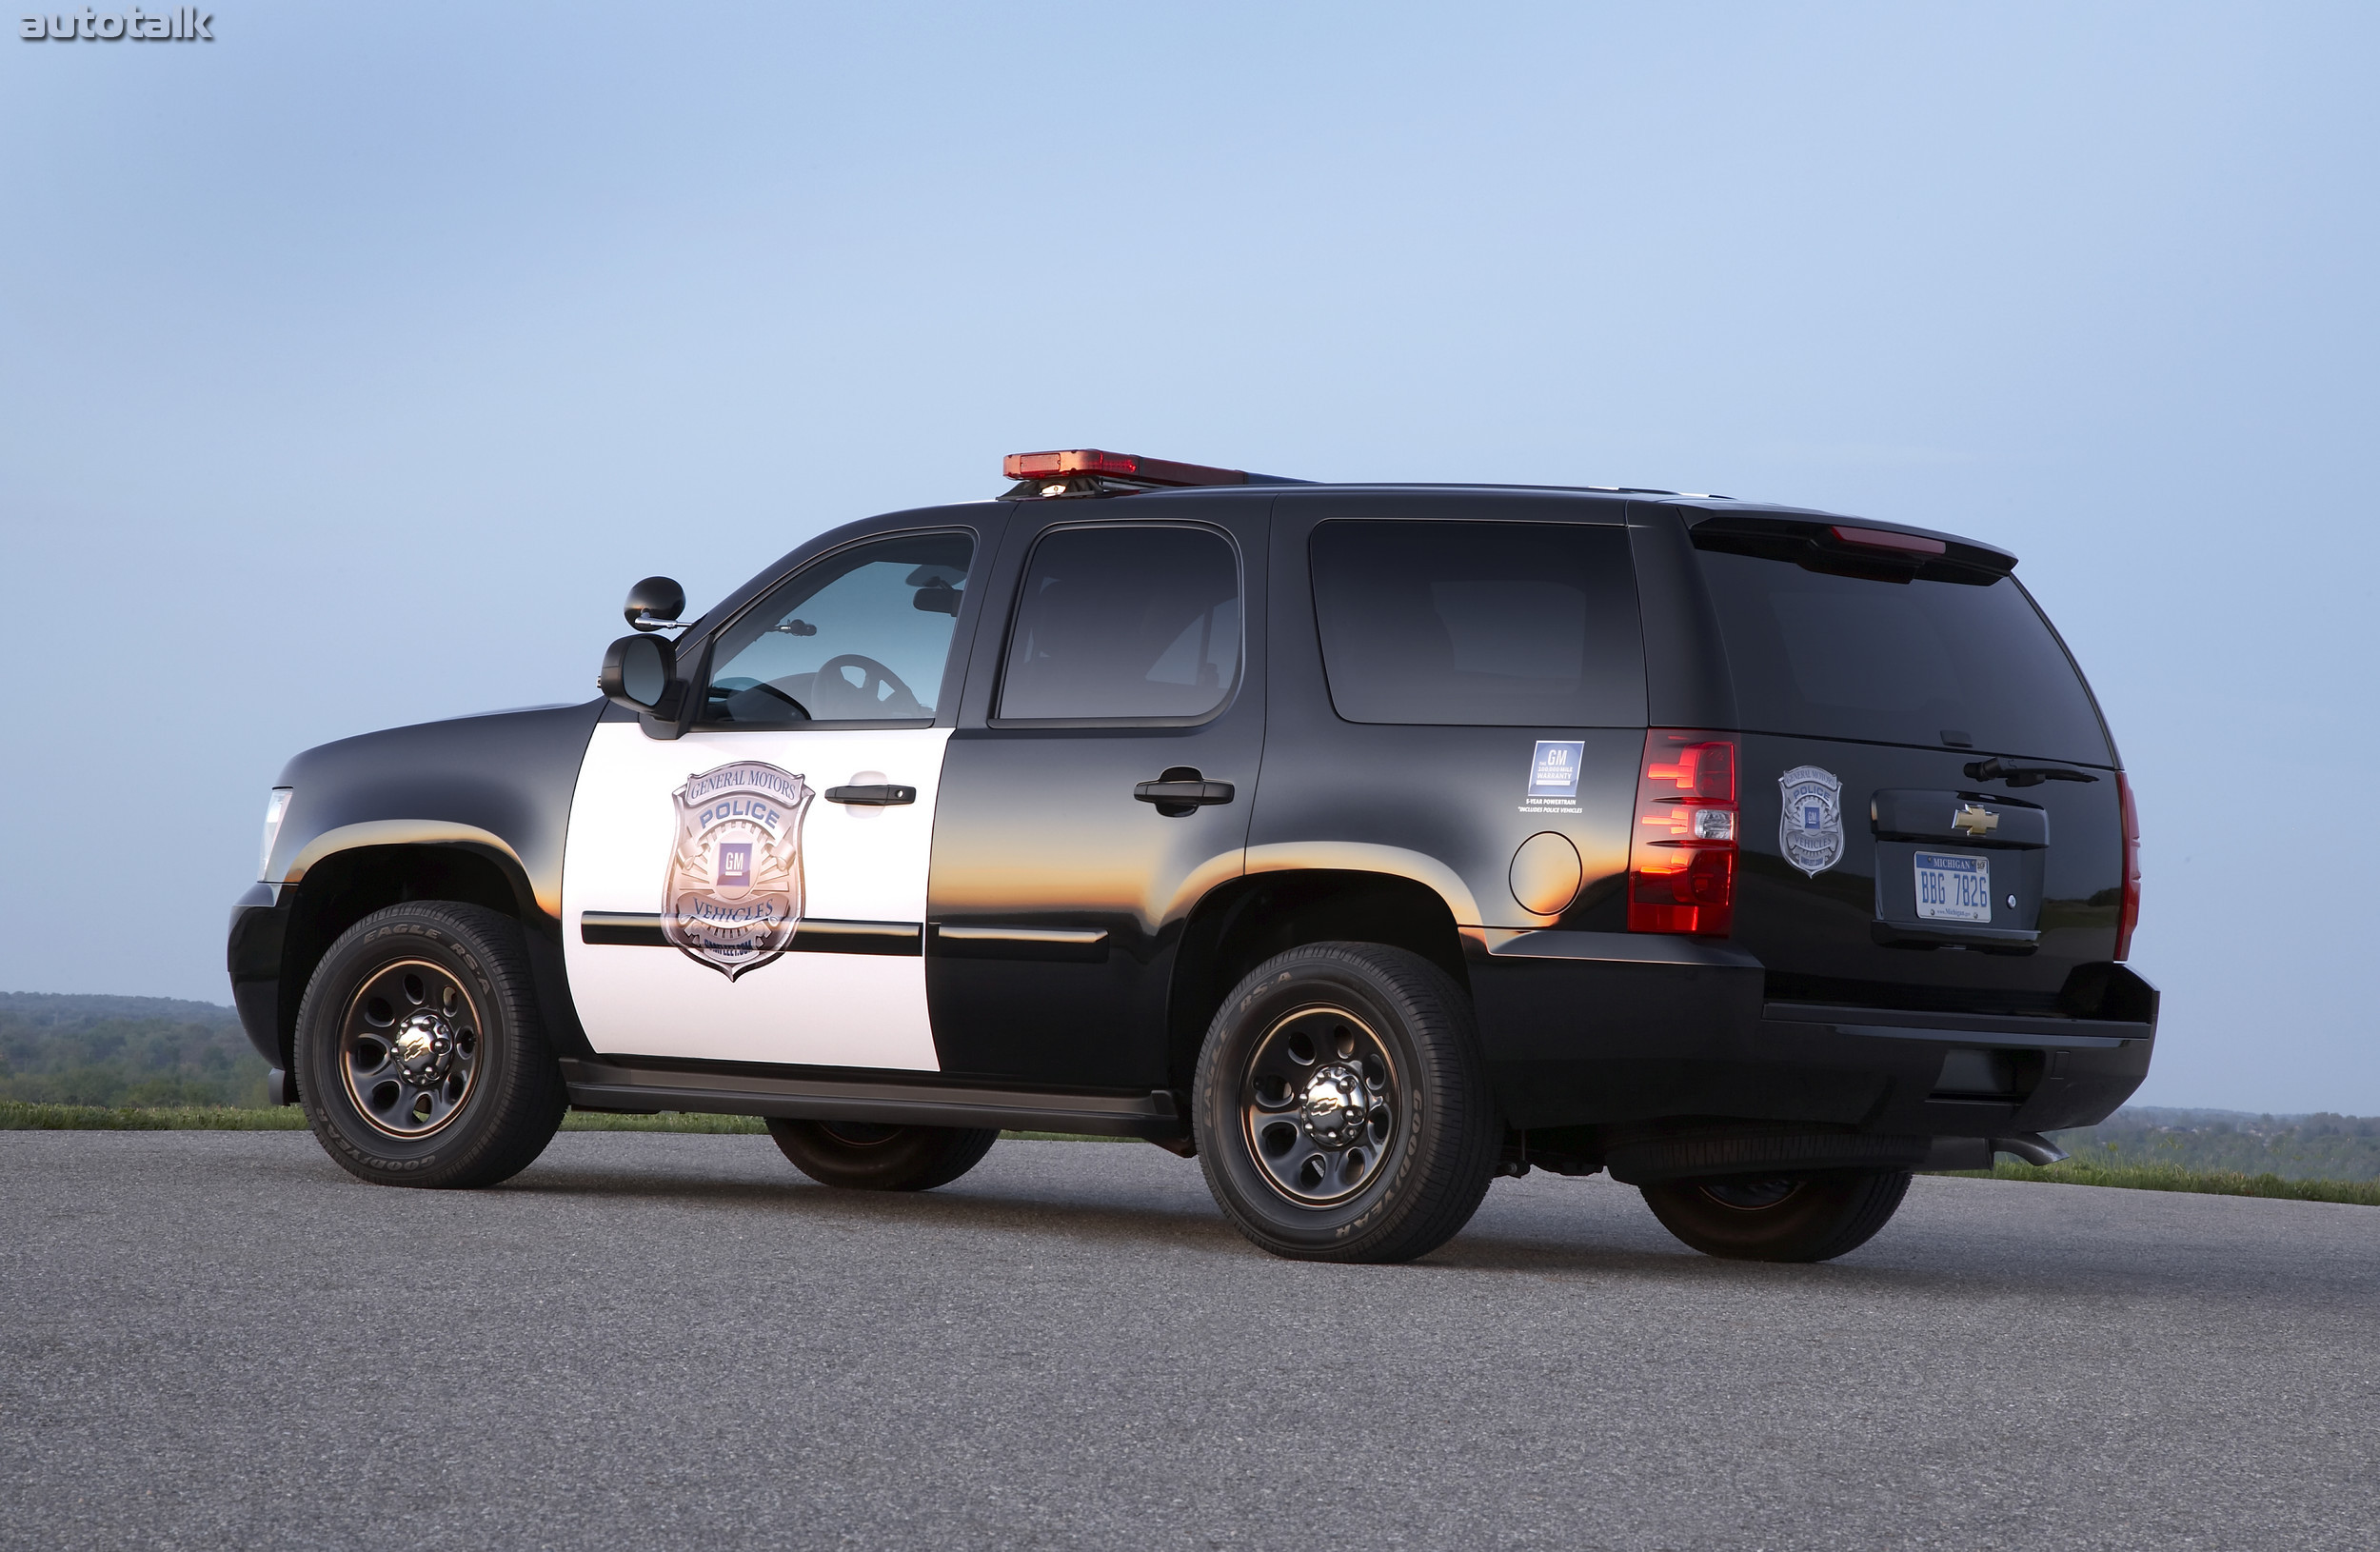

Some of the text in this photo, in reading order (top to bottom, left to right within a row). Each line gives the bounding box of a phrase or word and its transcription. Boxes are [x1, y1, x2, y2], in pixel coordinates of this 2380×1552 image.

[1547, 749, 1568, 766] GM
[691, 769, 796, 800] GENERAL MOTORS
[1786, 769, 1811, 785] GENERAL
[1793, 786, 1831, 802] POLICE
[699, 800, 781, 829] POLICE
[1808, 810, 1817, 820] GM
[1794, 834, 1832, 849] VEHICLES
[724, 851, 744, 870] GM
[1933, 858, 1971, 869] MICHIGAN
[1921, 870, 1988, 907] BBG 7826
[692, 896, 774, 923] VEHICLES
[364, 924, 442, 945] EAGLE
[1203, 1021, 1230, 1128] EAGLE
